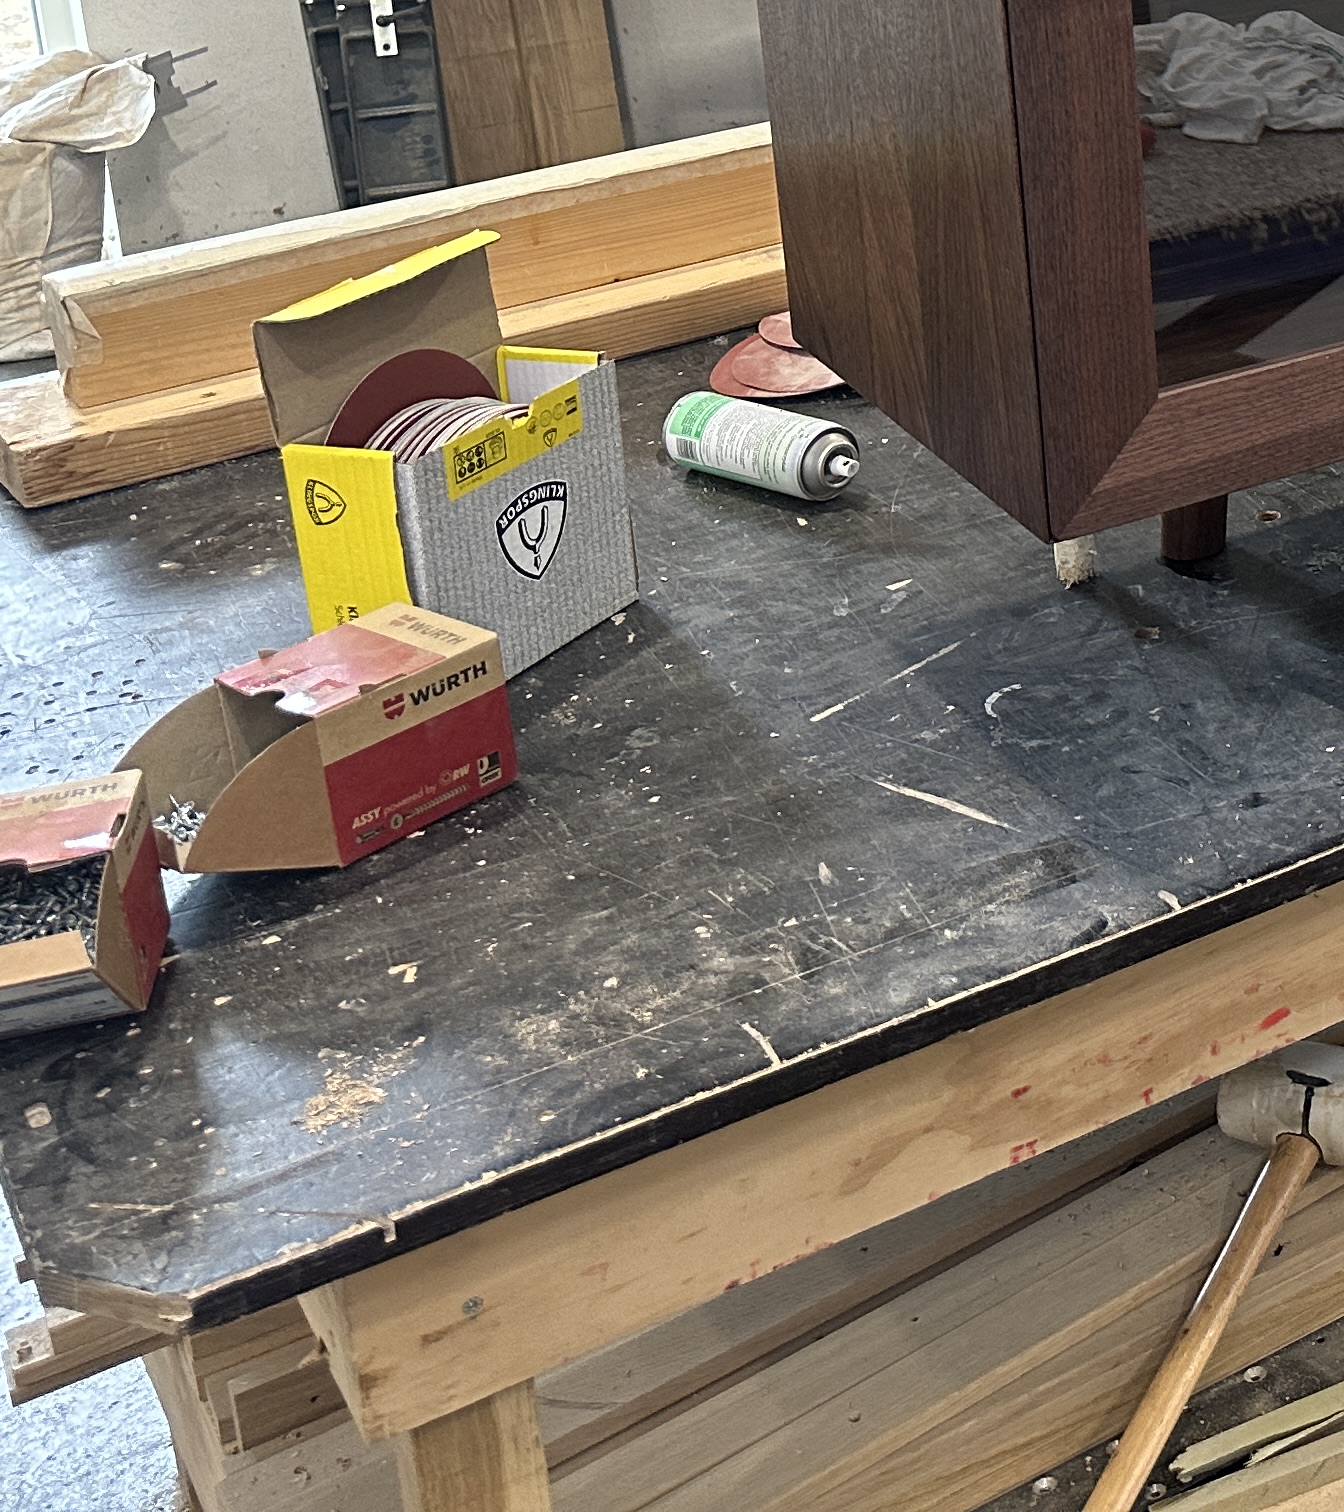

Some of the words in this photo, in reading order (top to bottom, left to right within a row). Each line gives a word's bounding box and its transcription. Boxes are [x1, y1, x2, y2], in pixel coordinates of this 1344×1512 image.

[499, 485, 565, 529] KLINGSPOR
[407, 621, 467, 645] WÜRTH
[409, 660, 488, 706] WÜRTH
[352, 806, 382, 830] ASSY
[383, 786, 424, 817] powered
[425, 783, 437, 795] by
